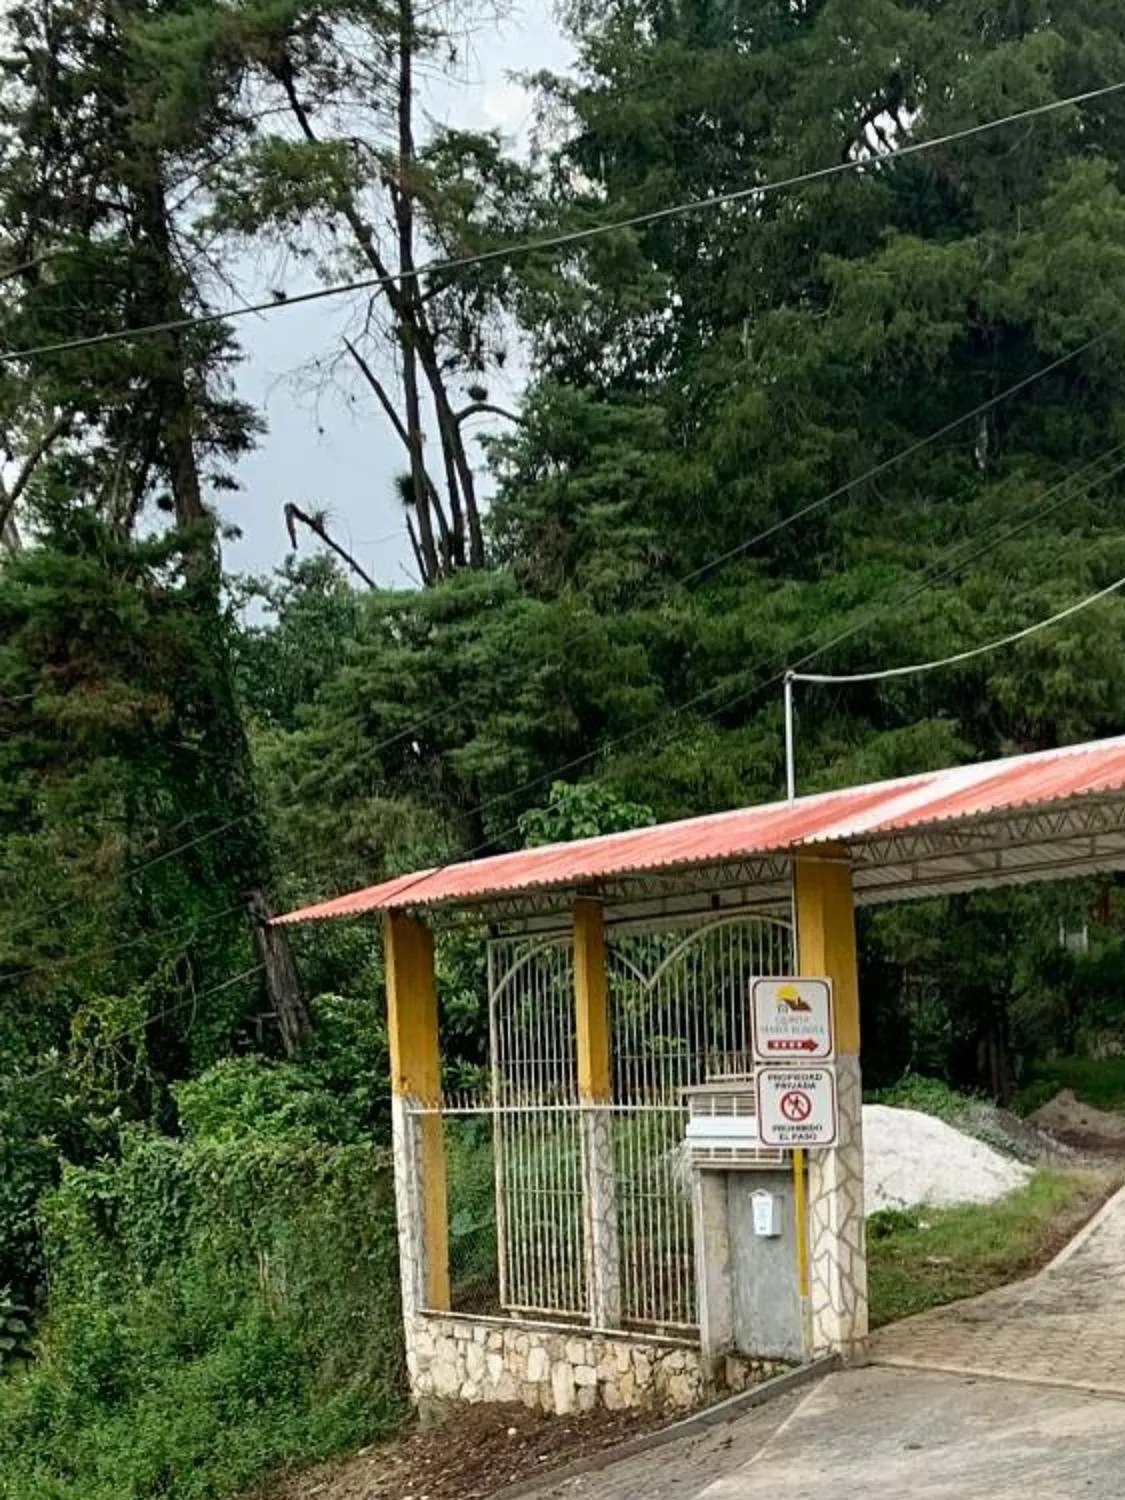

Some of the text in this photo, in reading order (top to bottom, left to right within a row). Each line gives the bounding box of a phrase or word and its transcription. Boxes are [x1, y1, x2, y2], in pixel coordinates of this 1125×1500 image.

[767, 1073, 823, 1081] PROPIEDAD
[775, 1081, 817, 1089] PRIVADA
[771, 1124, 823, 1132] PROHIBIDO
[779, 1132, 818, 1141] EL PASO
